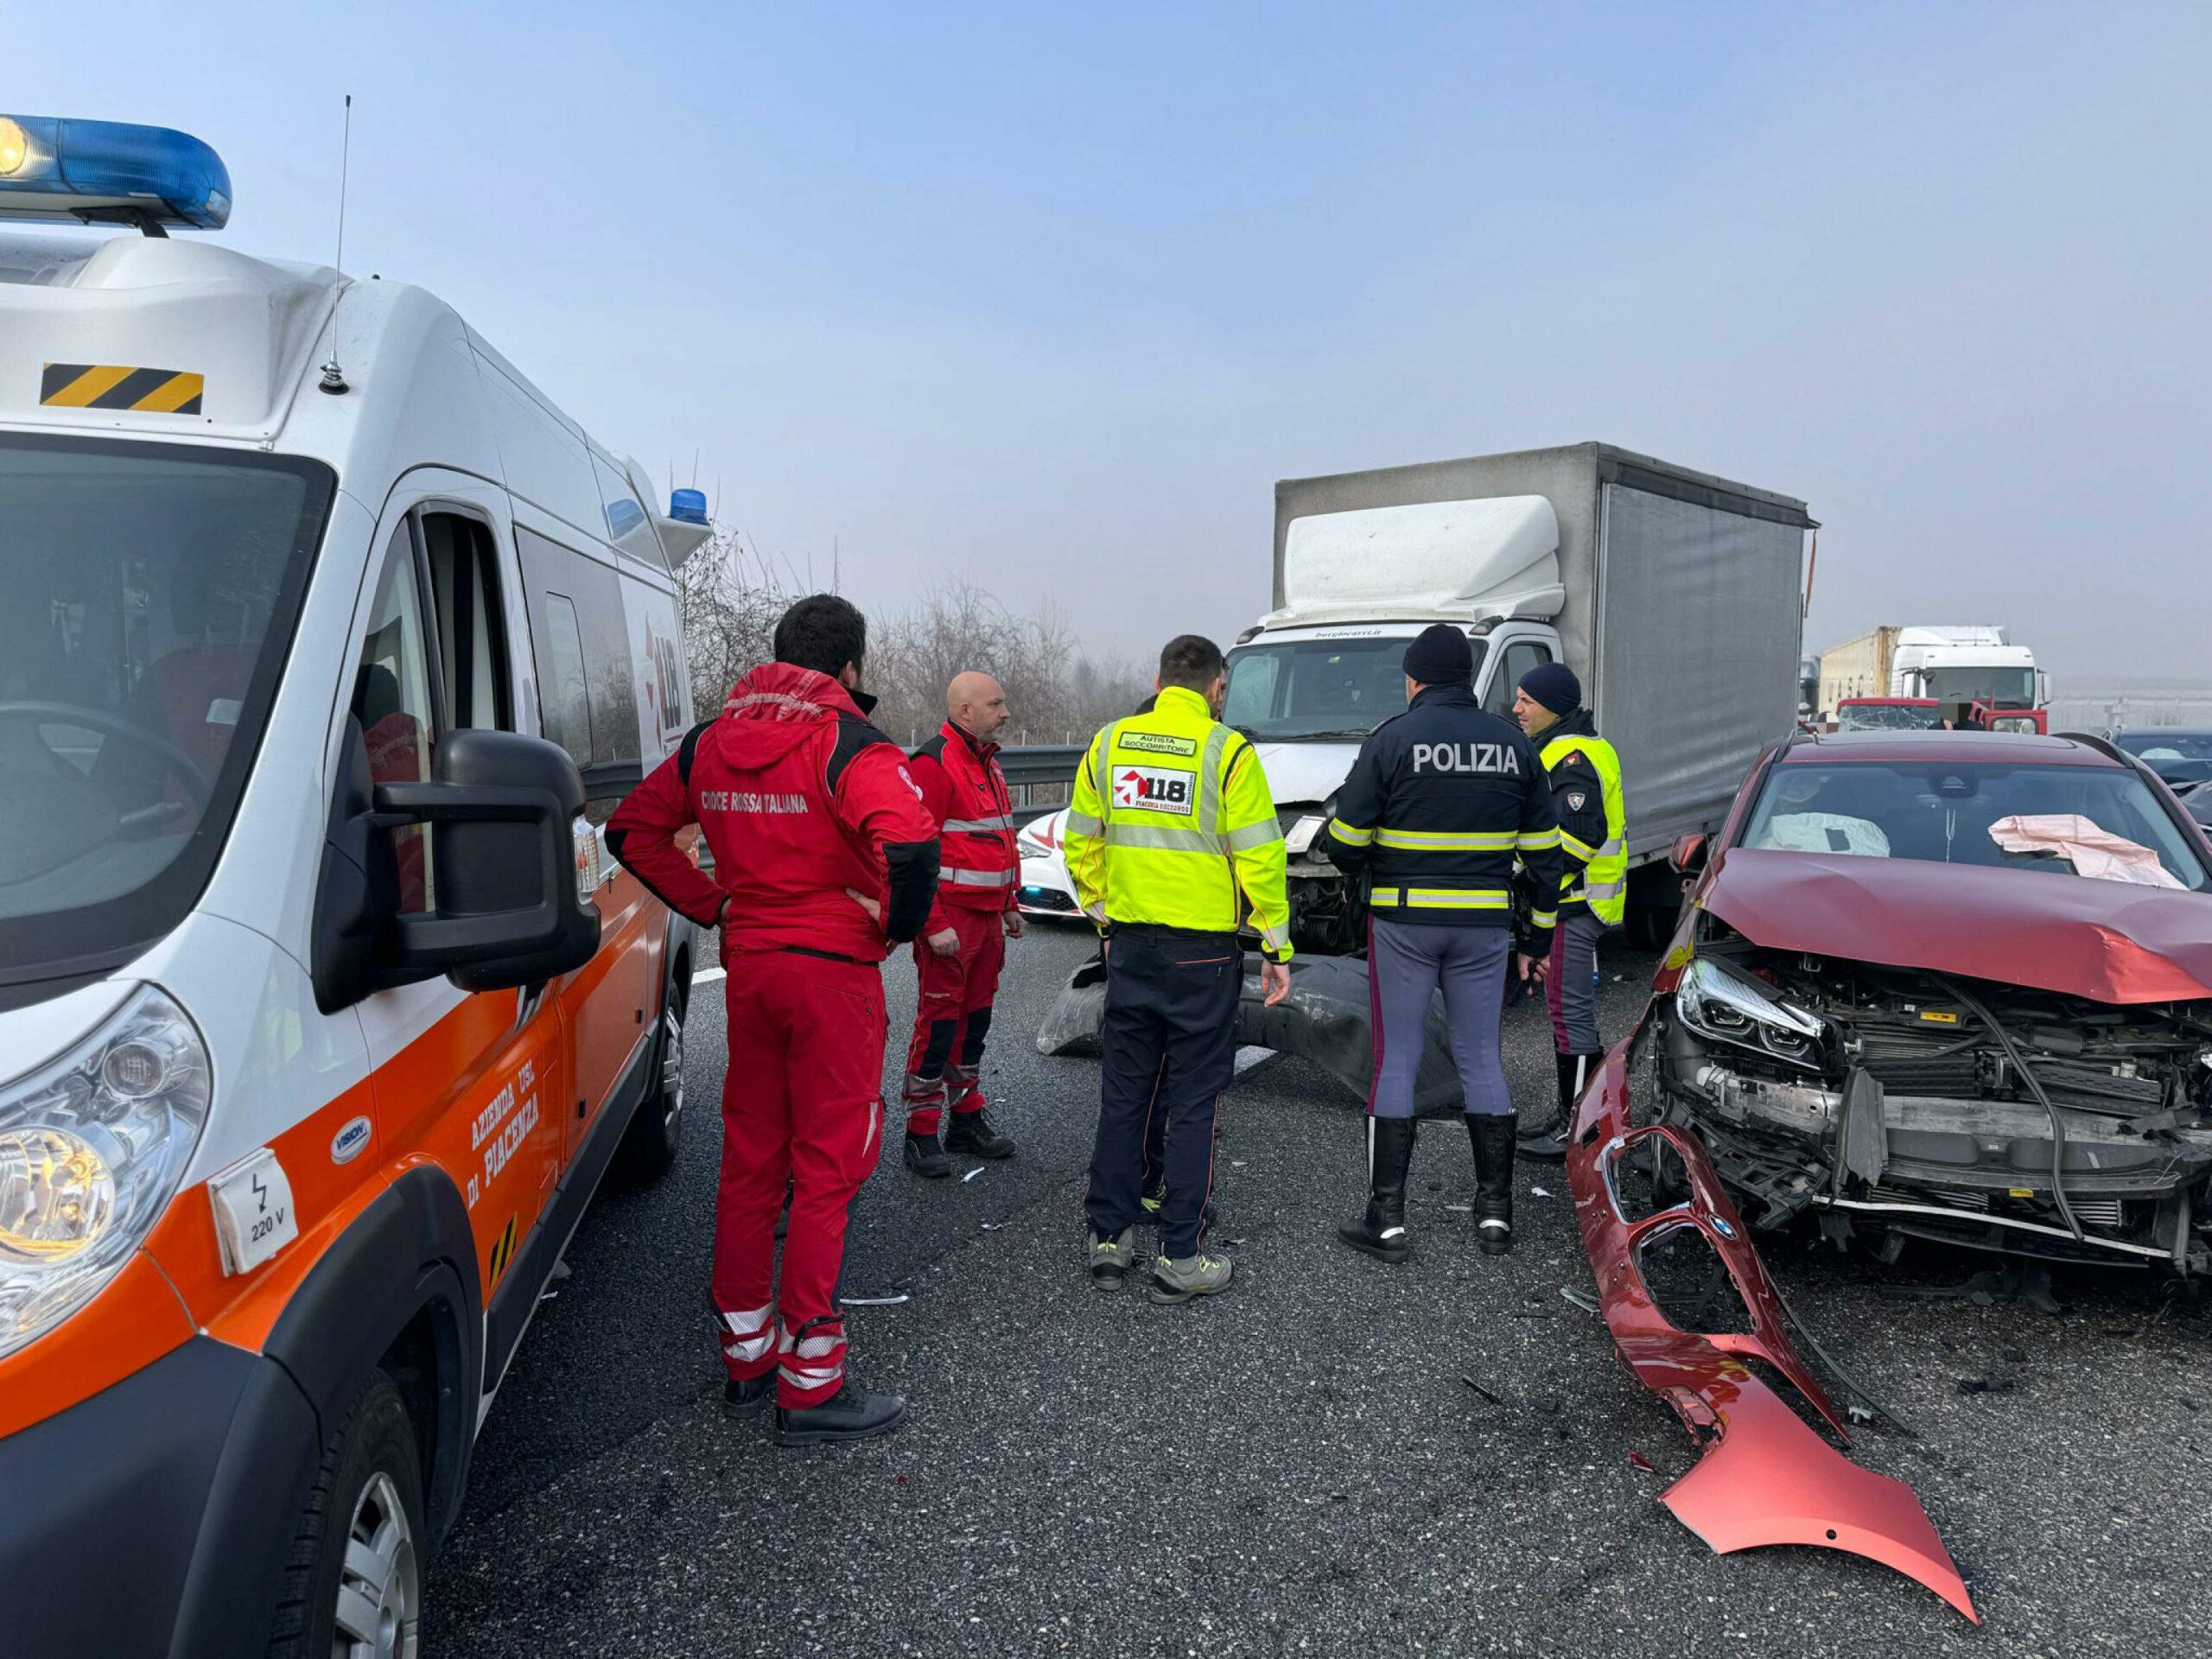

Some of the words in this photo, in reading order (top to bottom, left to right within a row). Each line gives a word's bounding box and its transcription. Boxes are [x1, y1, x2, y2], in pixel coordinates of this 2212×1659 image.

[655, 636, 681, 730] 118
[1124, 741, 1190, 753] SOCCORRITORE
[1140, 735, 1175, 744] AUTISTA
[1413, 743, 1519, 774] POLIZIA
[731, 792, 762, 814] ROSSA
[763, 794, 809, 814] TALIANA
[1144, 777, 1186, 803] 118
[472, 1081, 515, 1151] AZIENDA
[518, 1058, 536, 1094] USL
[336, 1122, 365, 1150] VISION
[467, 1173, 480, 1211] DI
[484, 1091, 539, 1188] PIACENZA
[251, 1216, 273, 1243] 220
[276, 1207, 284, 1225] V
